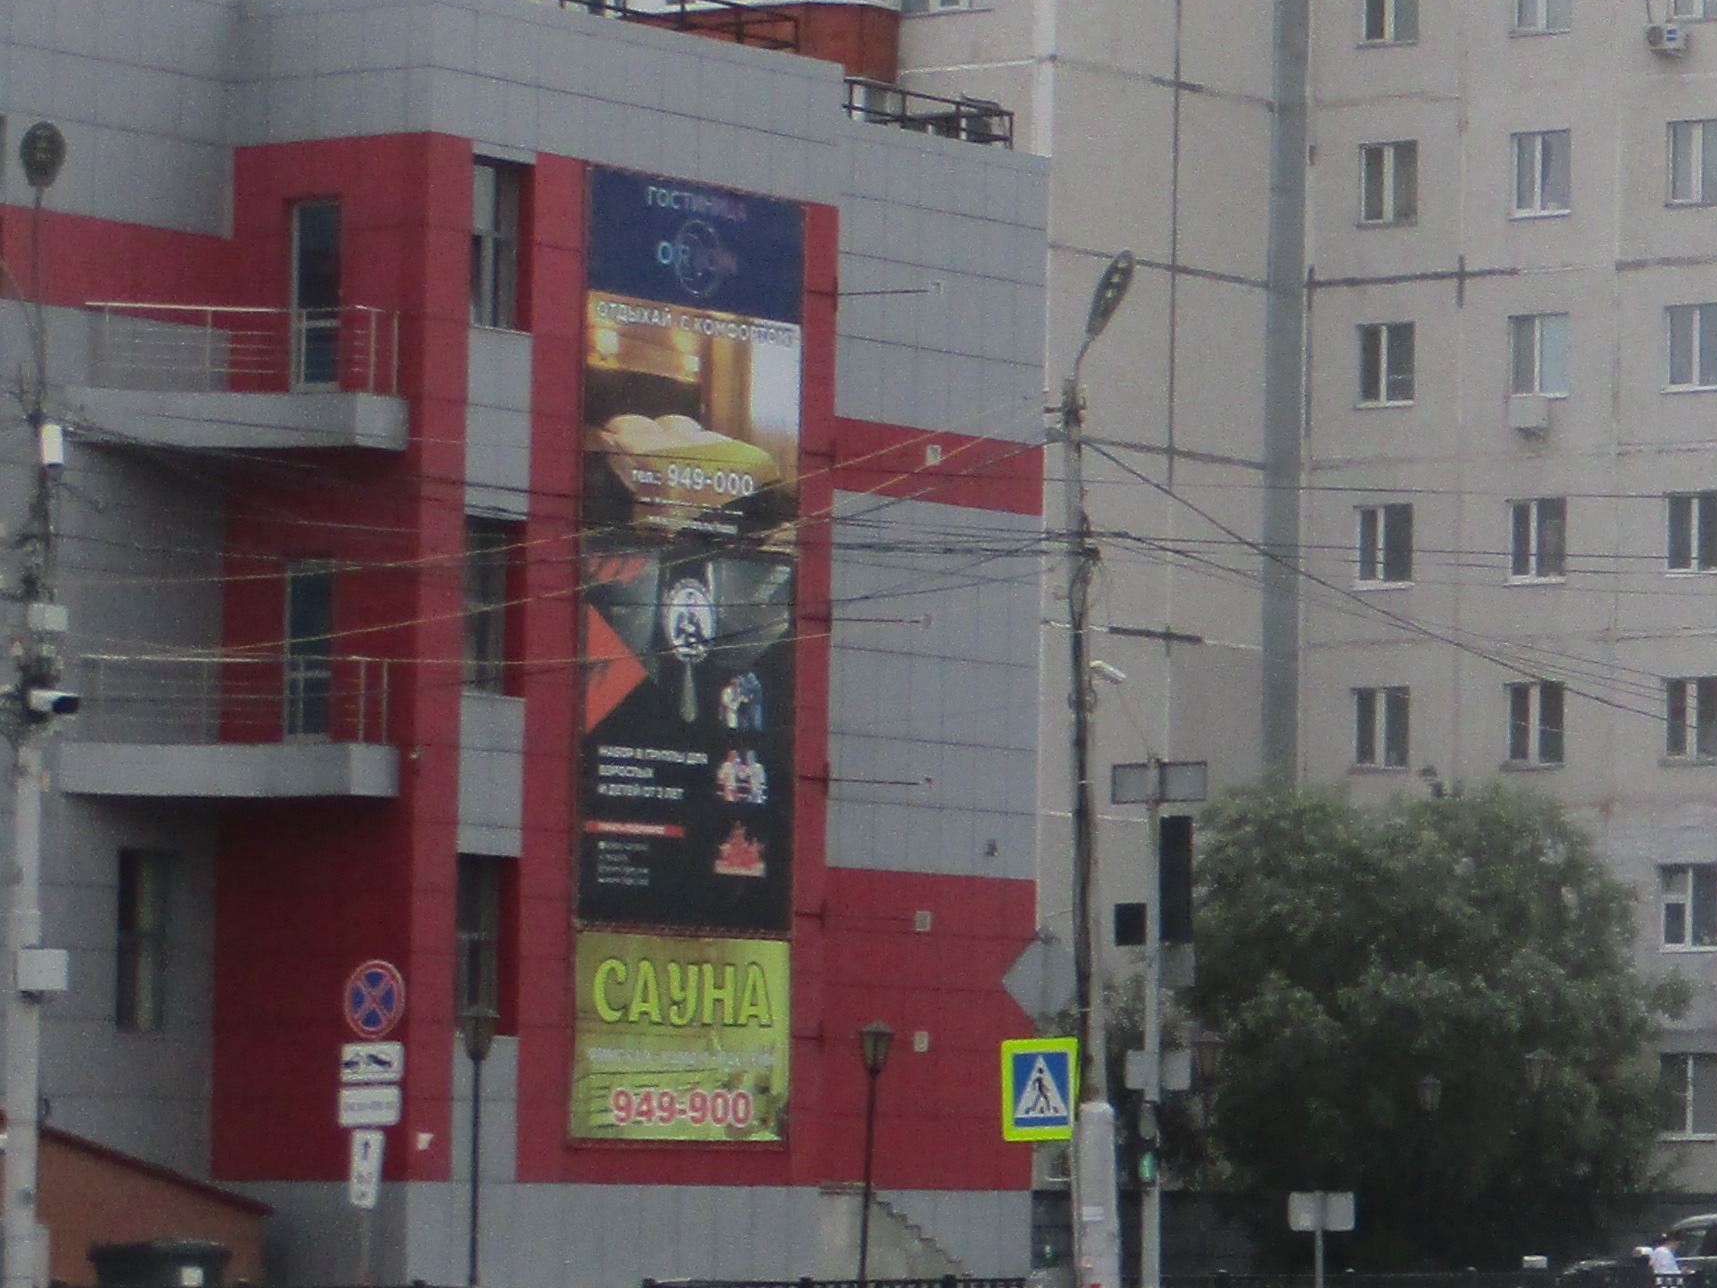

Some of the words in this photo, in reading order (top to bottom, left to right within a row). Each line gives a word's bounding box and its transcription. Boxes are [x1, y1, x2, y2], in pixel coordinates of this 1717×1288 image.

[597, 300, 672, 327] ОТДЫХАЙ
[680, 314, 690, 331] С
[667, 463, 754, 496] 949-000
[593, 957, 773, 1028] САУНА
[611, 1088, 753, 1127] 949-900
